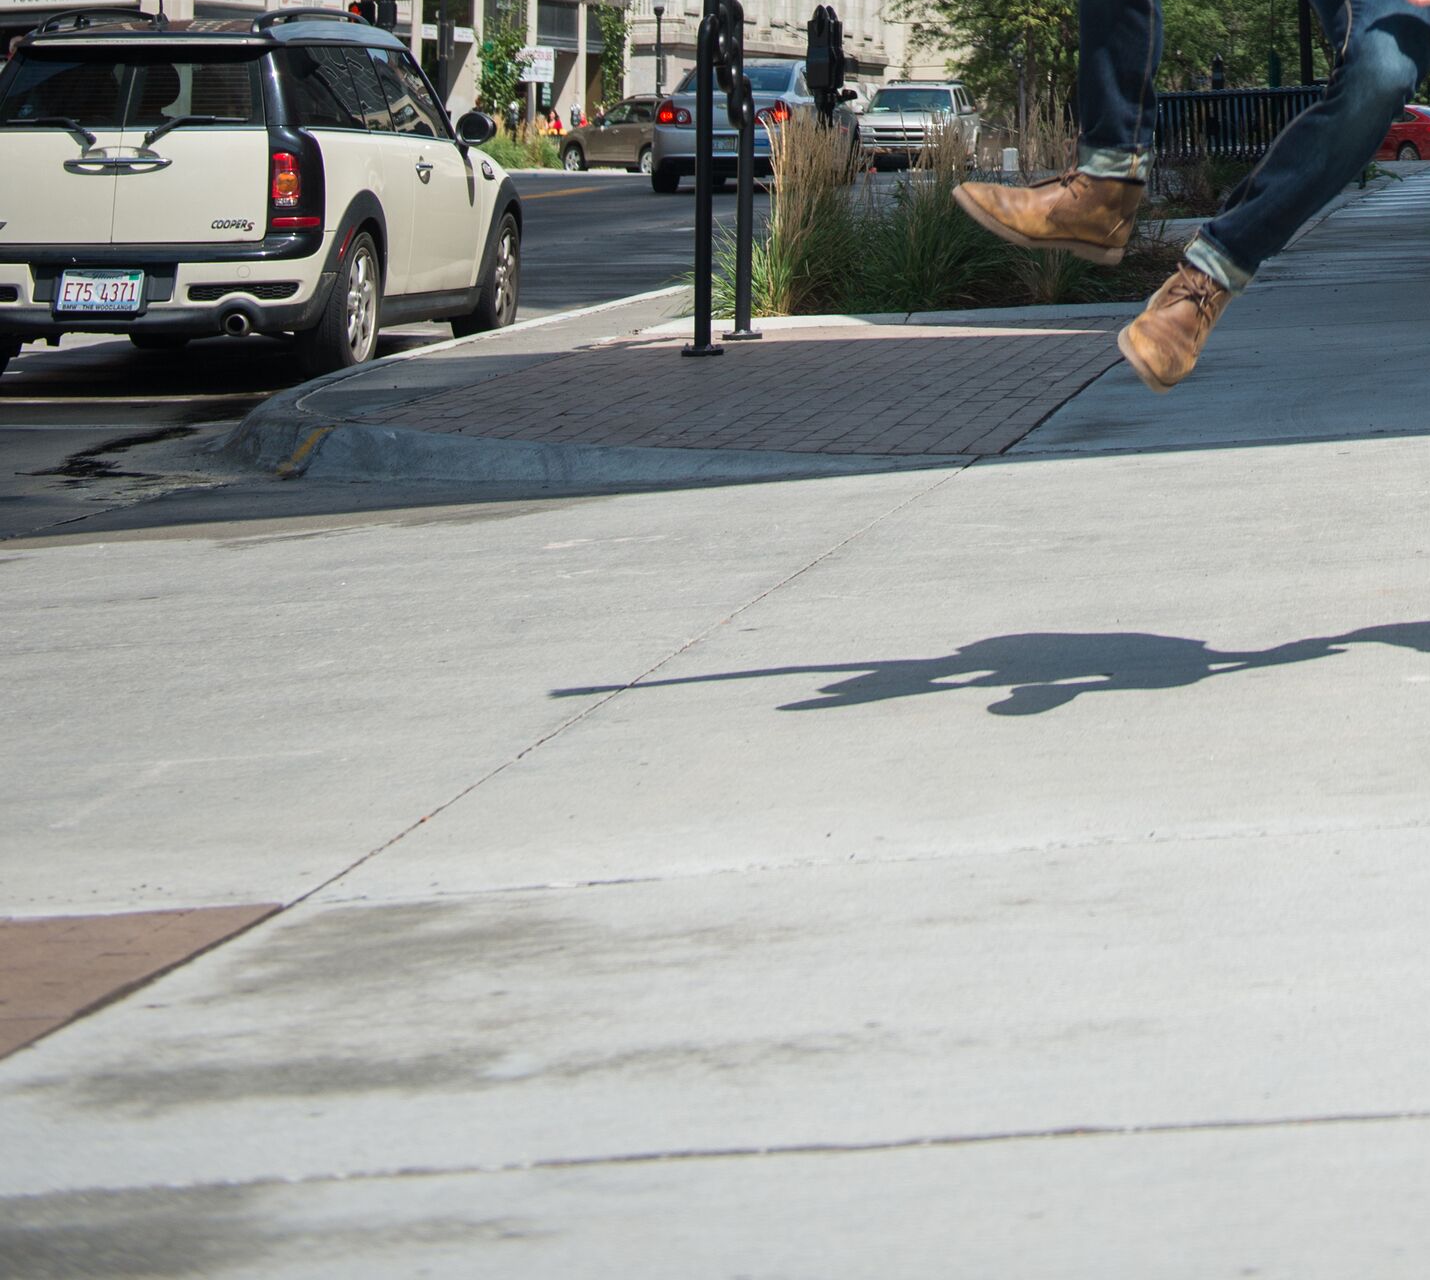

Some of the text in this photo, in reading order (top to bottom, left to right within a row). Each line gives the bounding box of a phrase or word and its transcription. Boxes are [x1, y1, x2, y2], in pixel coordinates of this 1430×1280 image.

[211, 219, 248, 229] COOPER
[63, 282, 136, 302] E75 4371
